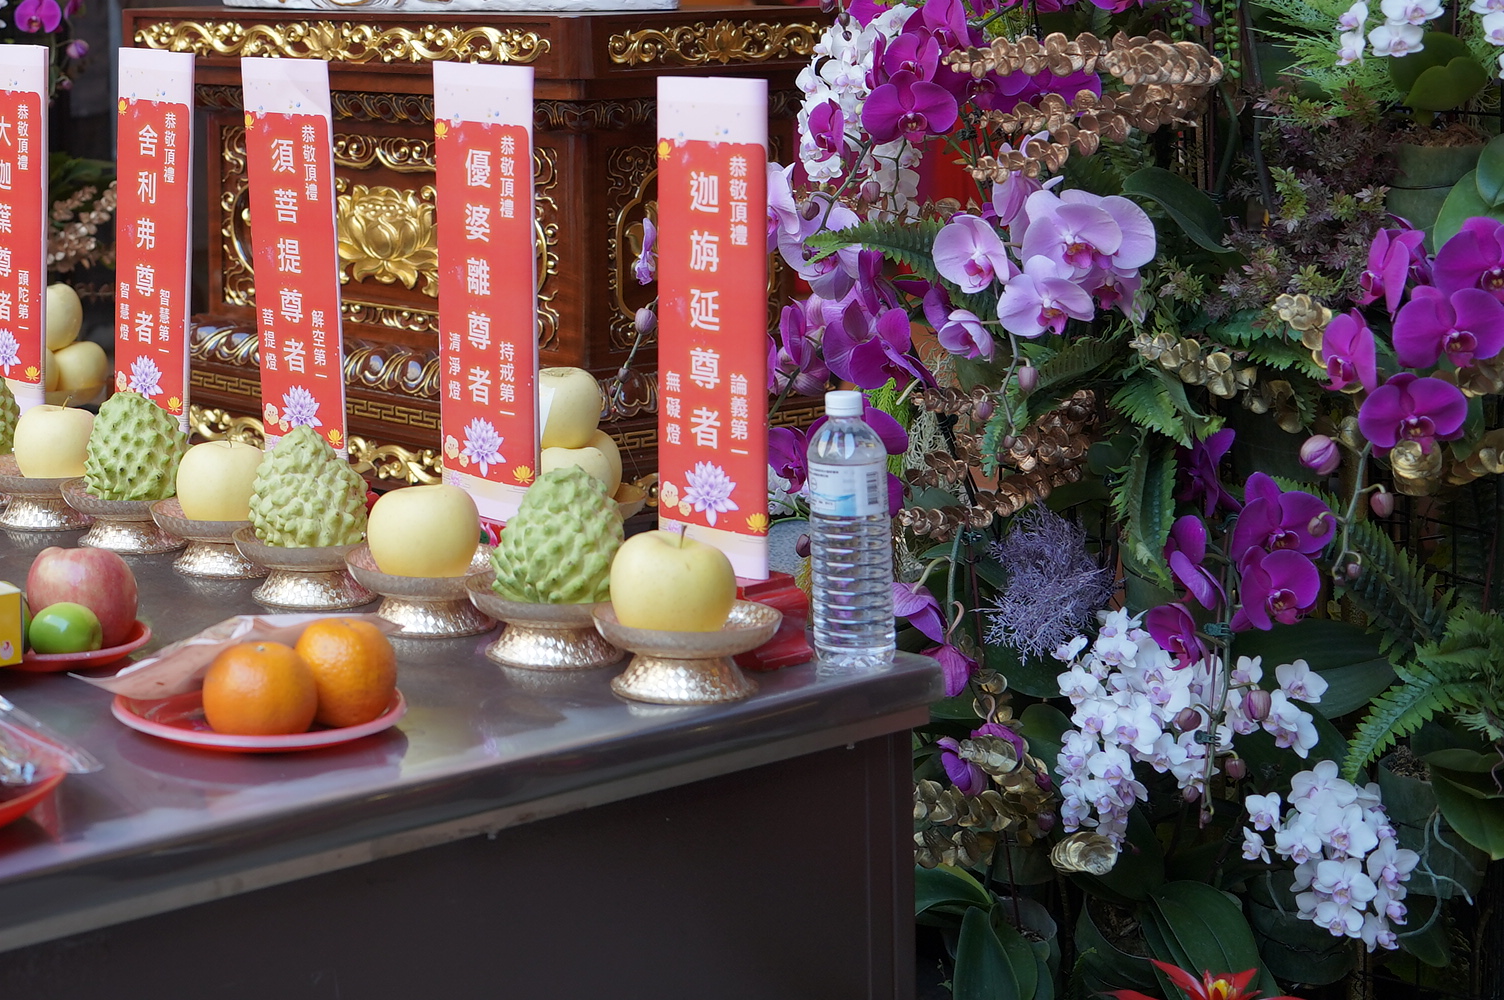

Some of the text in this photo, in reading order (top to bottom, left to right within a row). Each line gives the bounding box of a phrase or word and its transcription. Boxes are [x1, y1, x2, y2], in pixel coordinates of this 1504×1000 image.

[17, 104, 29, 171] 恭敬頂禮
[163, 112, 177, 184] 恭敬頂禮
[301, 124, 319, 202] 恭敬頂禮
[500, 135, 515, 219] 恭敬頂禮
[729, 155, 748, 246] 恭敬頂禮
[135, 124, 159, 345] 舍利弗尊者
[270, 138, 307, 375] 須菩提尊者
[18, 270, 30, 331] 頭陀第一
[119, 281, 130, 342] 智慧燈
[464, 148, 492, 406] 優婆離尊者
[689, 170, 721, 450] 迦旃延尊者
[158, 288, 171, 354] 智慧第一
[262, 308, 278, 372] 菩提燈
[311, 309, 328, 380] 解空第一
[448, 331, 462, 401] 清淨燈
[499, 341, 515, 416] 持戒第一
[666, 371, 681, 446] 無礙燈
[730, 373, 749, 455] 論義第一
